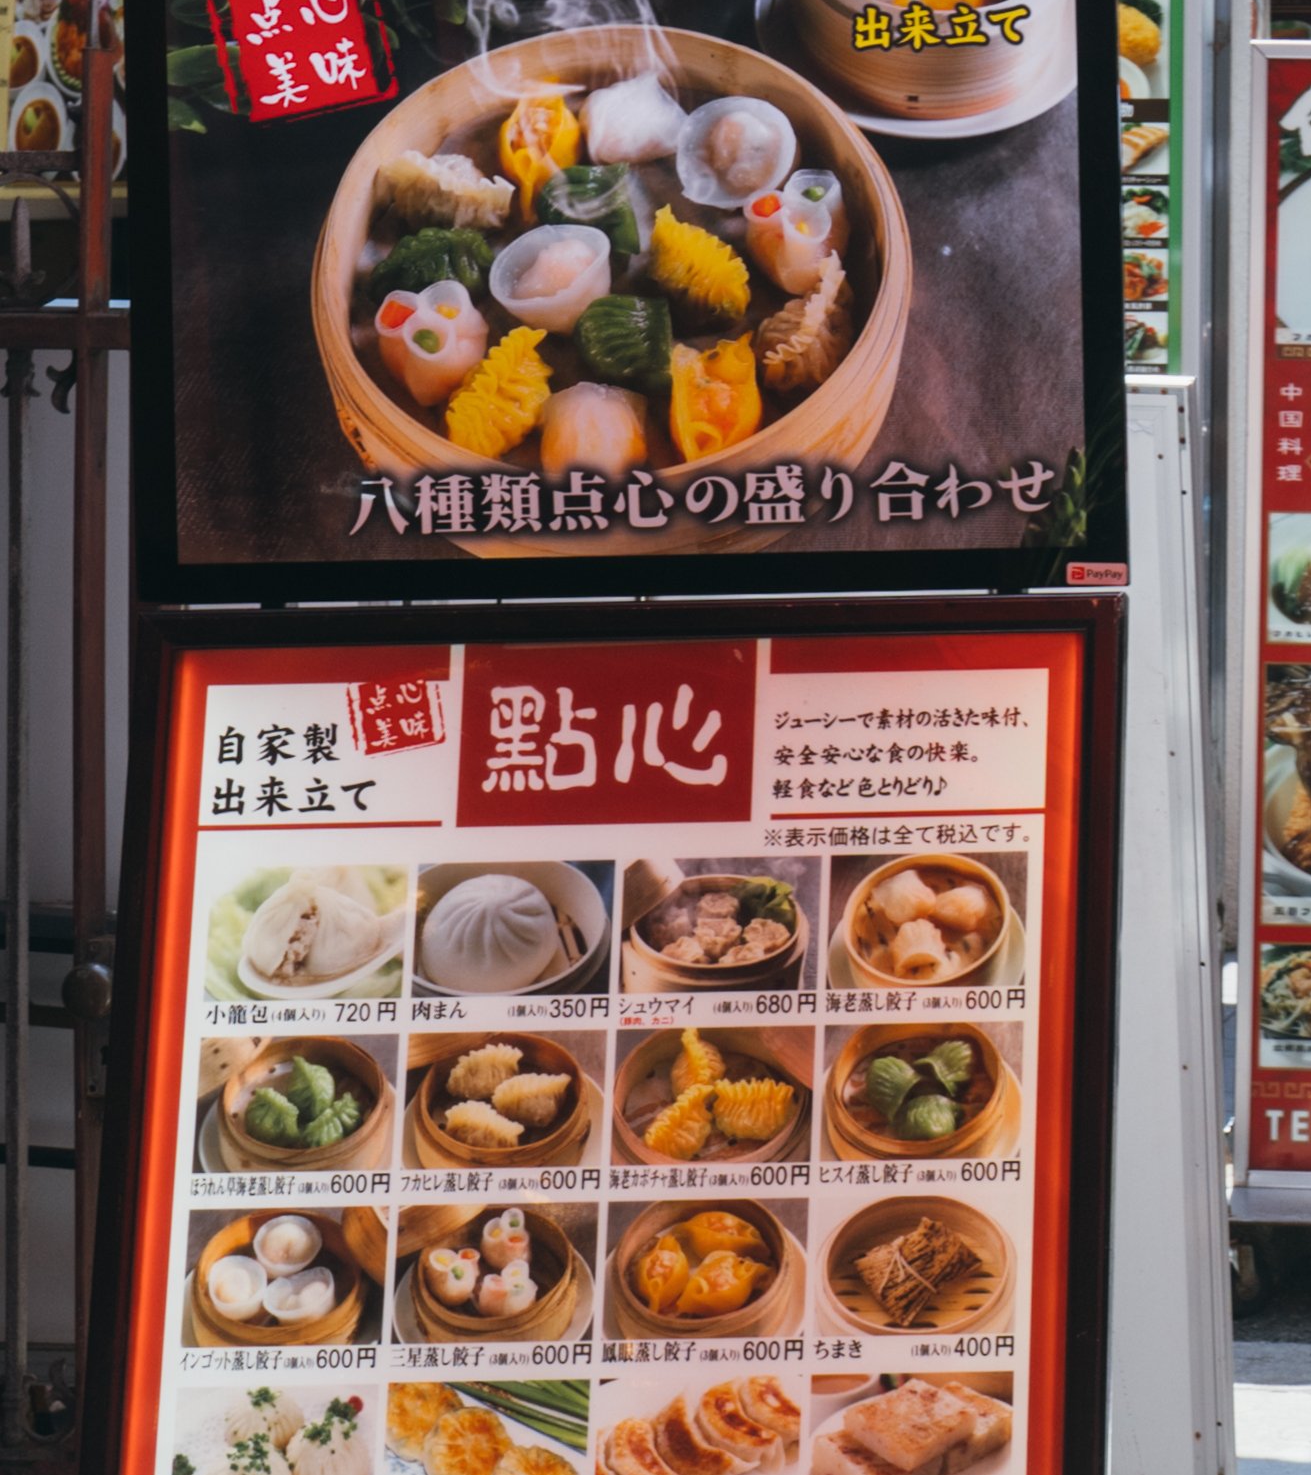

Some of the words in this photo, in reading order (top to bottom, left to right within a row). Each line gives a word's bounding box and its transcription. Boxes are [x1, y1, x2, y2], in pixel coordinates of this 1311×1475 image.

[851, 1, 1032, 55] 出来立て
[259, 45, 369, 112] 美味
[1276, 382, 1304, 482] 中国料理
[347, 452, 1058, 539] 八種類点心の盛り合わせ
[1086, 568, 1123, 581] PayPay
[367, 679, 425, 715] 点心
[370, 710, 431, 750] 美味
[773, 705, 1031, 731] ジューシーで素材の活きた味付、
[216, 722, 342, 767] 自家製
[481, 681, 734, 797] 點心
[772, 740, 979, 767] 安全安心な食の快楽。
[211, 775, 378, 818] 出来立て
[205, 1003, 268, 1025] 小籠包
[334, 1001, 398, 1023] 720円
[411, 1001, 467, 1021] 肉まん
[549, 997, 610, 1019] 350円
[618, 996, 696, 1016] シュウマイ
[756, 993, 817, 1015] 680円
[825, 990, 918, 1013] 海老蒸し餃子
[965, 988, 1026, 1010] 600円
[330, 1172, 391, 1195] 600円
[401, 1171, 494, 1193] フカヒレ蒸し餃子
[539, 1168, 601, 1190] 600円
[608, 1168, 708, 1190] 海老カボチャ蒸し餃子
[750, 1164, 810, 1186] 600円
[818, 1163, 914, 1186] ヒスイ蒸し餃子
[960, 1160, 1021, 1183] 600円
[180, 1350, 283, 1372] インゴット蒸し餃子
[315, 1347, 377, 1369] 600円
[390, 1347, 485, 1369] 三星蒸し餃子
[531, 1343, 593, 1365] 600円
[742, 1339, 804, 1362] 600円
[813, 1339, 864, 1360] ちまき
[953, 1336, 1015, 1358] 400円
